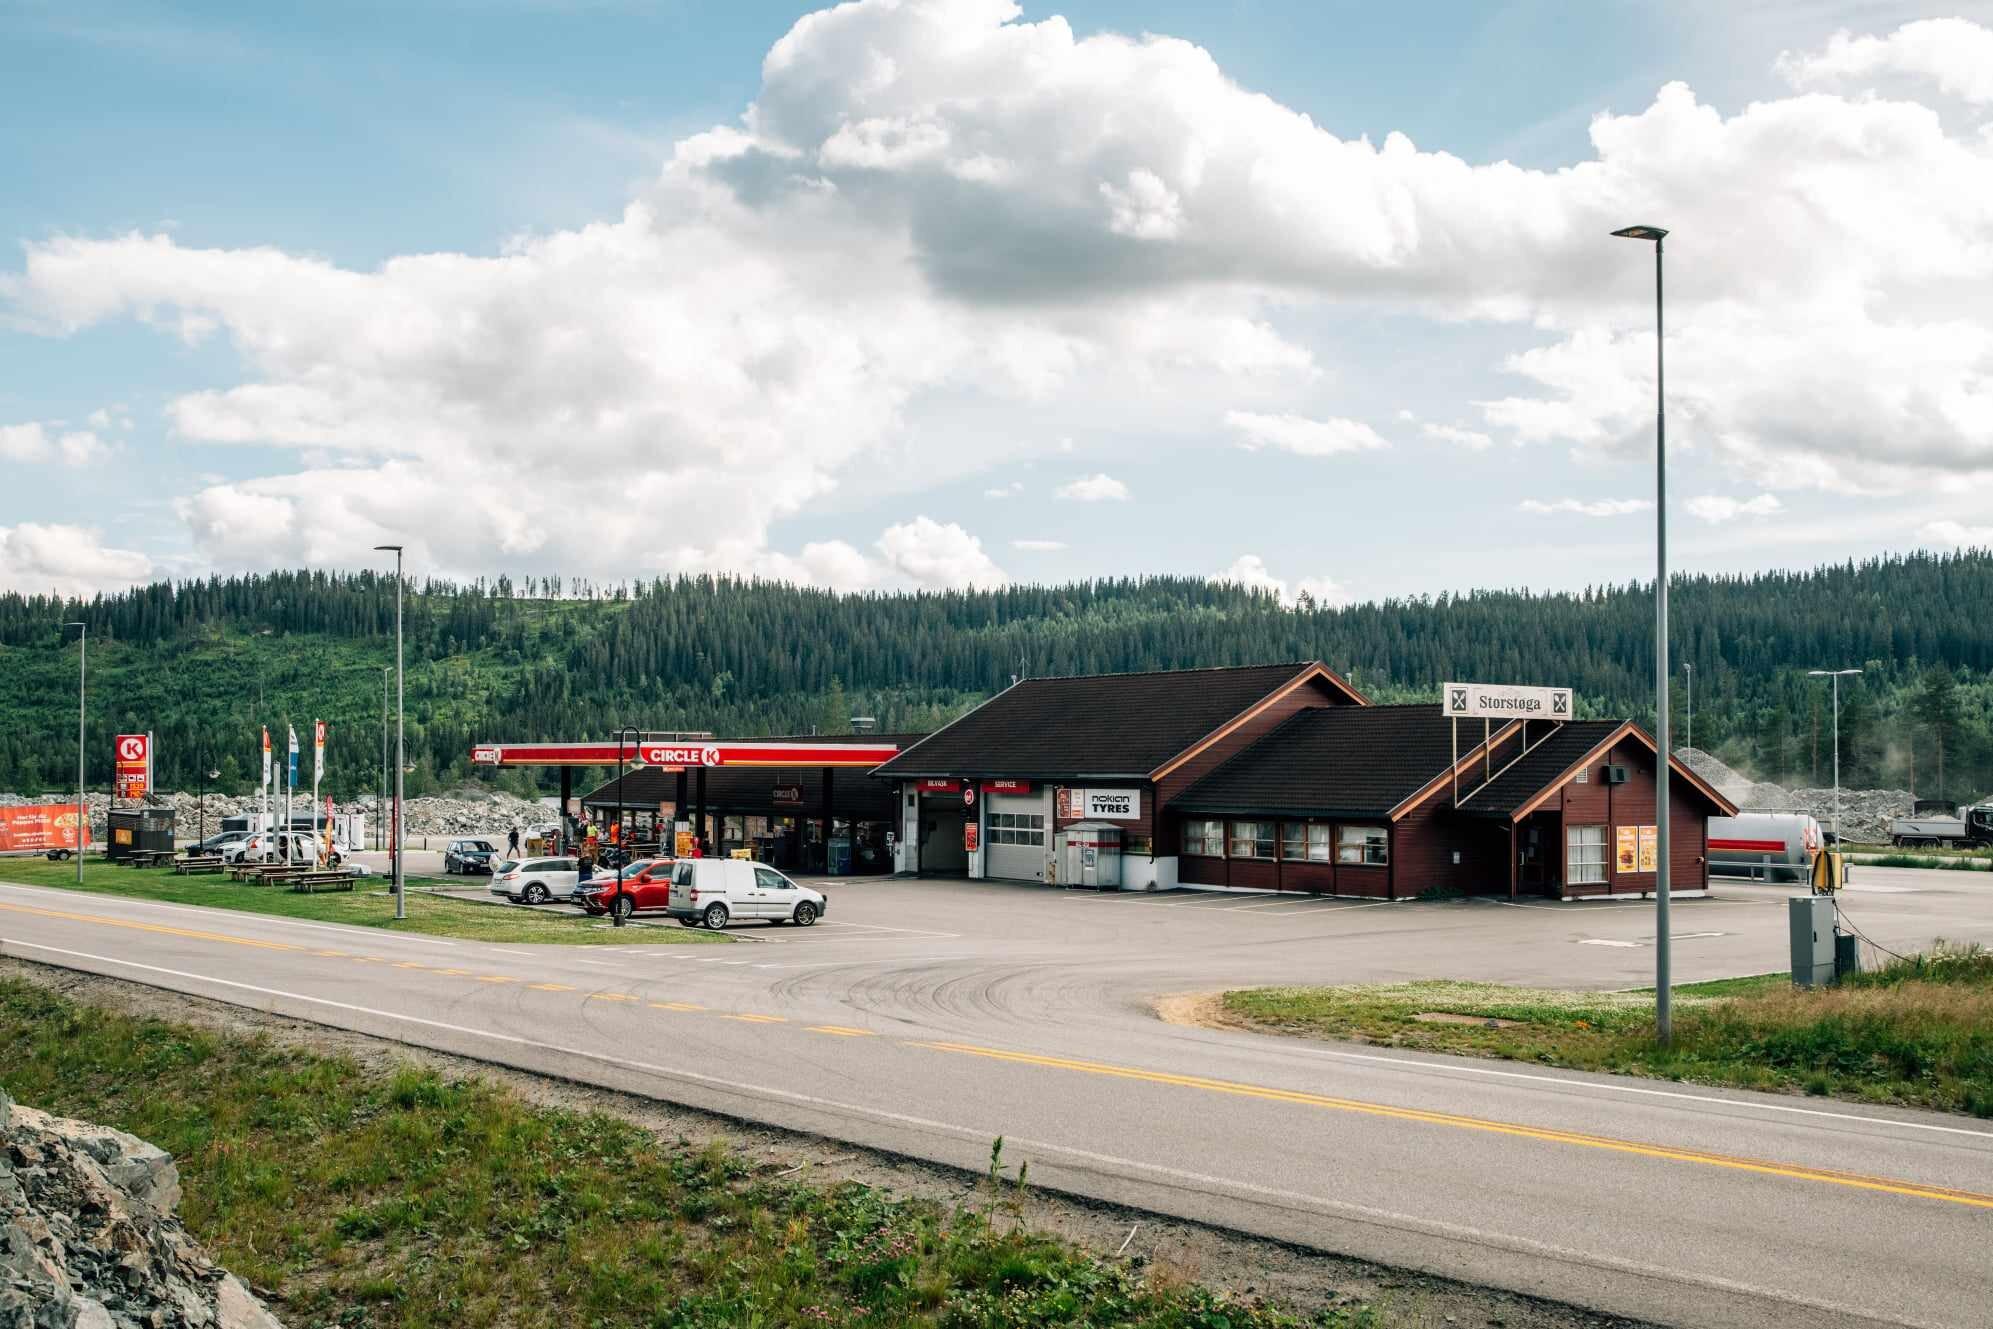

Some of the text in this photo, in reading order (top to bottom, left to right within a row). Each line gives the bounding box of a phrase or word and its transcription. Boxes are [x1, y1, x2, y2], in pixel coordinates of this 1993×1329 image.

[1479, 695, 1542, 713] Storstøga
[650, 748, 720, 766] CIRCLE K
[1091, 795, 1130, 803] nokian
[1092, 803, 1130, 814] TYRES
